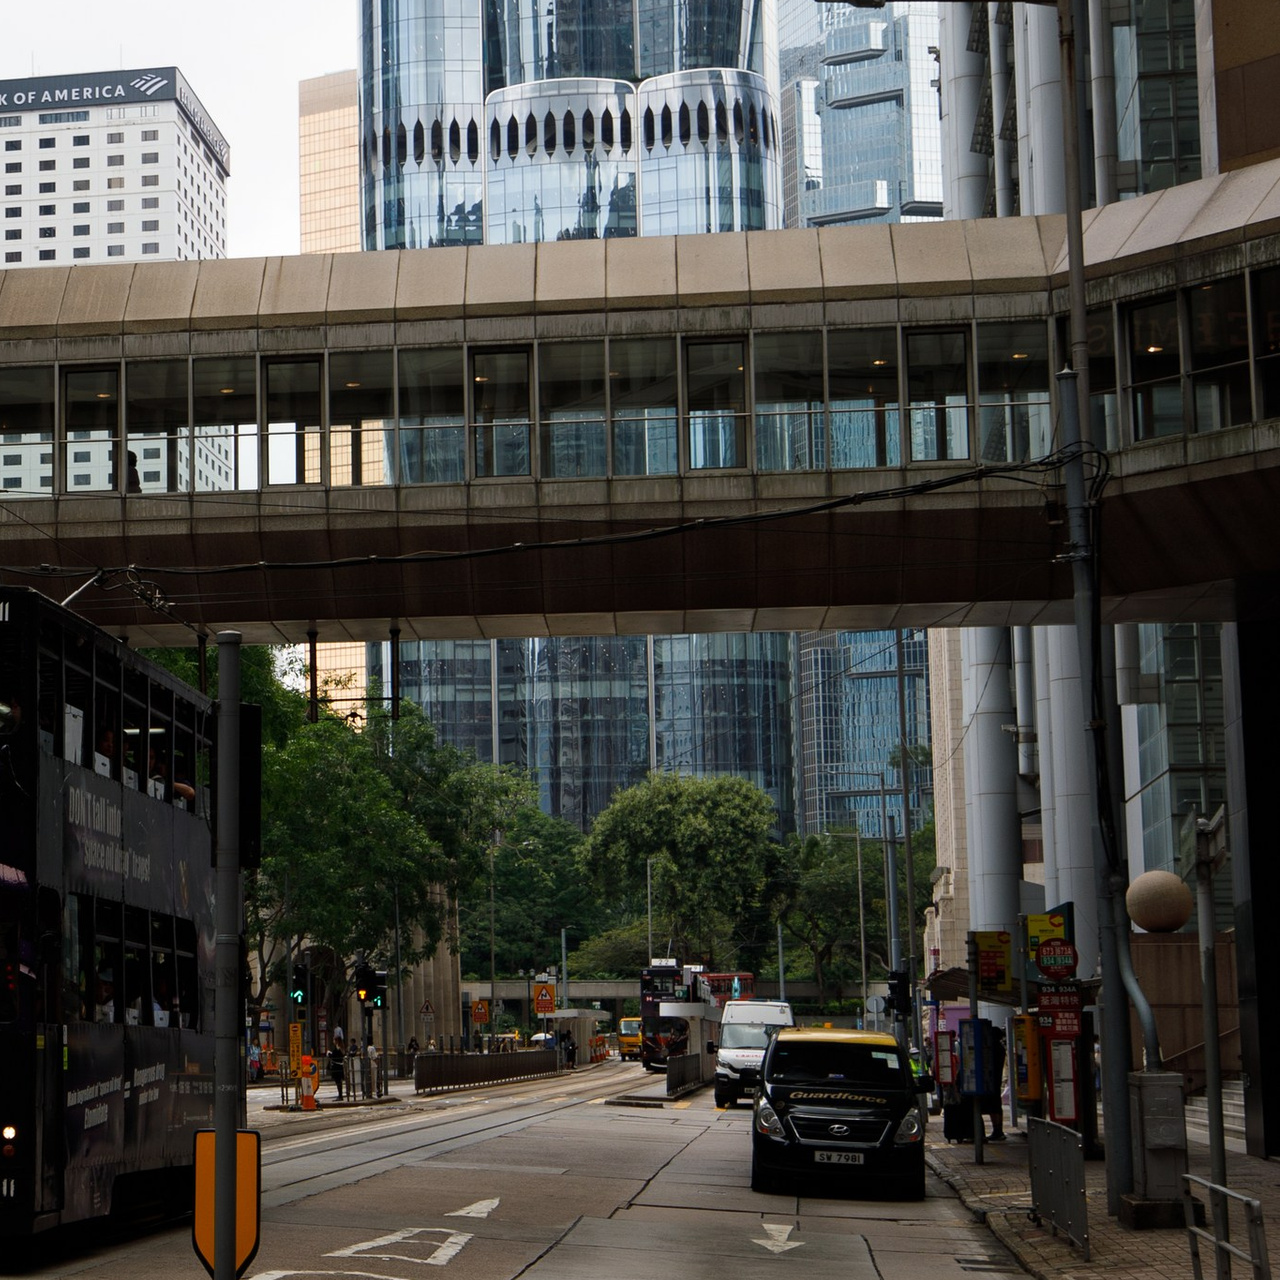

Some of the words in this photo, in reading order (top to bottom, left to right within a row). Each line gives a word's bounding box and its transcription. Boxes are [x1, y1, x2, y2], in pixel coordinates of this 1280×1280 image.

[13, 91, 37, 105] OF
[40, 84, 126, 103] AMERICA
[1041, 985, 1056, 993] 934
[1058, 985, 1078, 993] 934A
[1038, 1016, 1053, 1024] 934
[789, 1091, 888, 1105] Guardforce
[819, 1153, 832, 1162] SW
[836, 1154, 861, 1163] 7981
